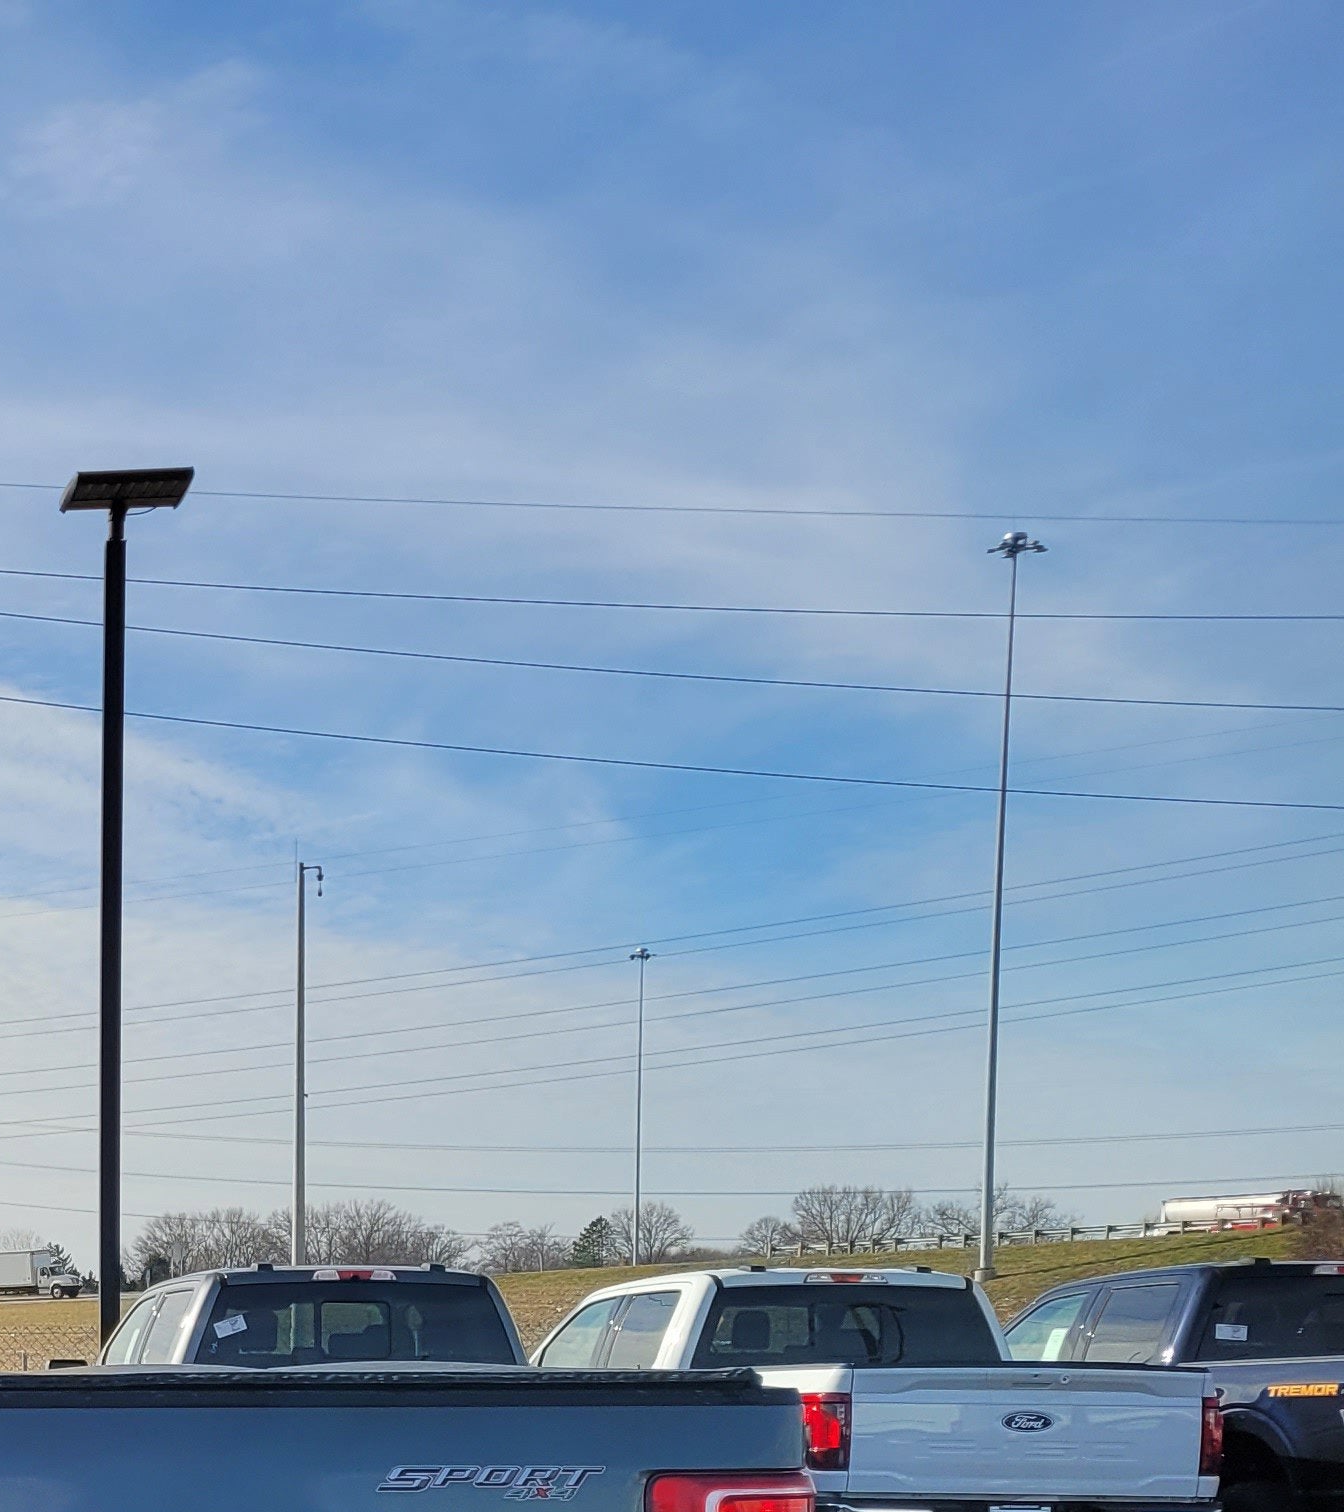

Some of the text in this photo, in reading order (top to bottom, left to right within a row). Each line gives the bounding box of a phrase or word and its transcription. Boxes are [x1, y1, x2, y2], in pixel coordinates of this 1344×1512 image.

[1267, 1384, 1339, 1398] TREMOR
[1010, 1414, 1046, 1429] Ford
[376, 1465, 606, 1493] SPORT
